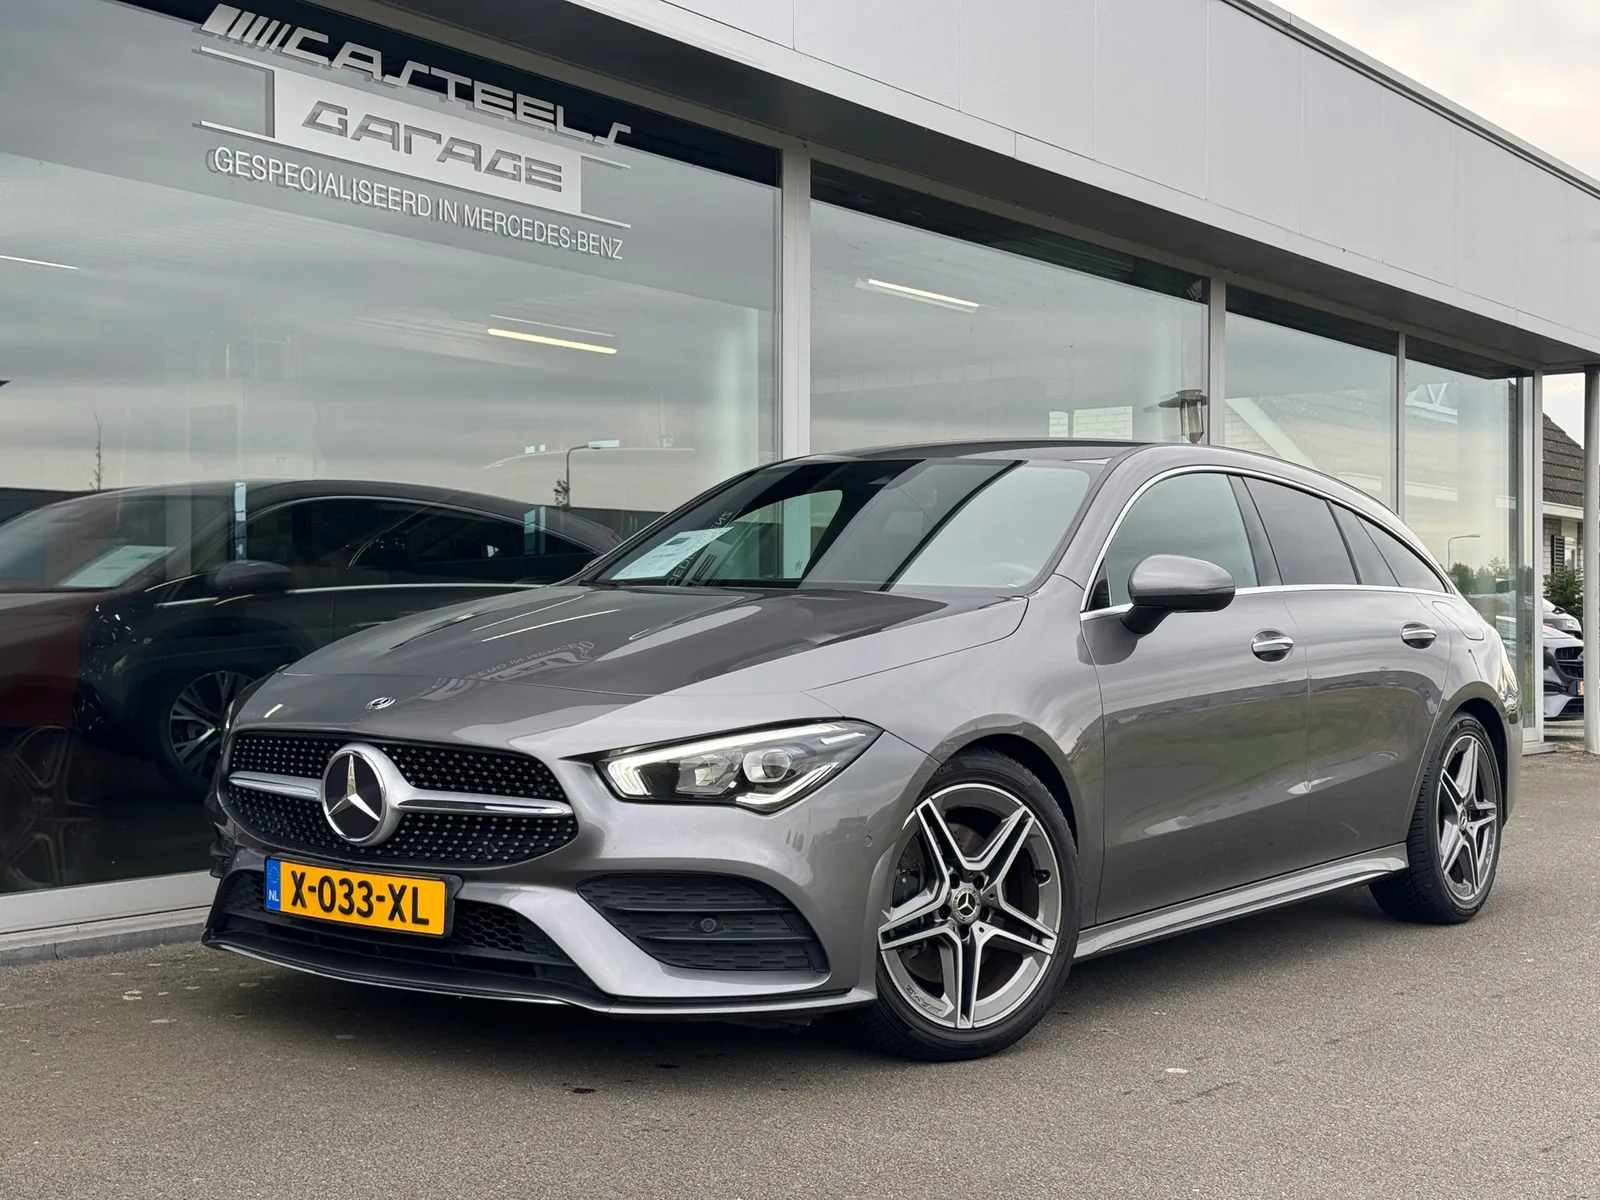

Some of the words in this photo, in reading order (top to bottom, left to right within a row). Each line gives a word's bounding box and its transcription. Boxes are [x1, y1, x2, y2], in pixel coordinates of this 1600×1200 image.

[282, 26, 631, 146] CASTEELS
[302, 100, 562, 193] GARAGE
[213, 146, 432, 218] GESPECIALISEERD
[438, 199, 458, 225] IN
[463, 207, 624, 260] MERCEDES-BENZ
[268, 889, 280, 902] NL
[290, 869, 430, 926] X-033-XL
